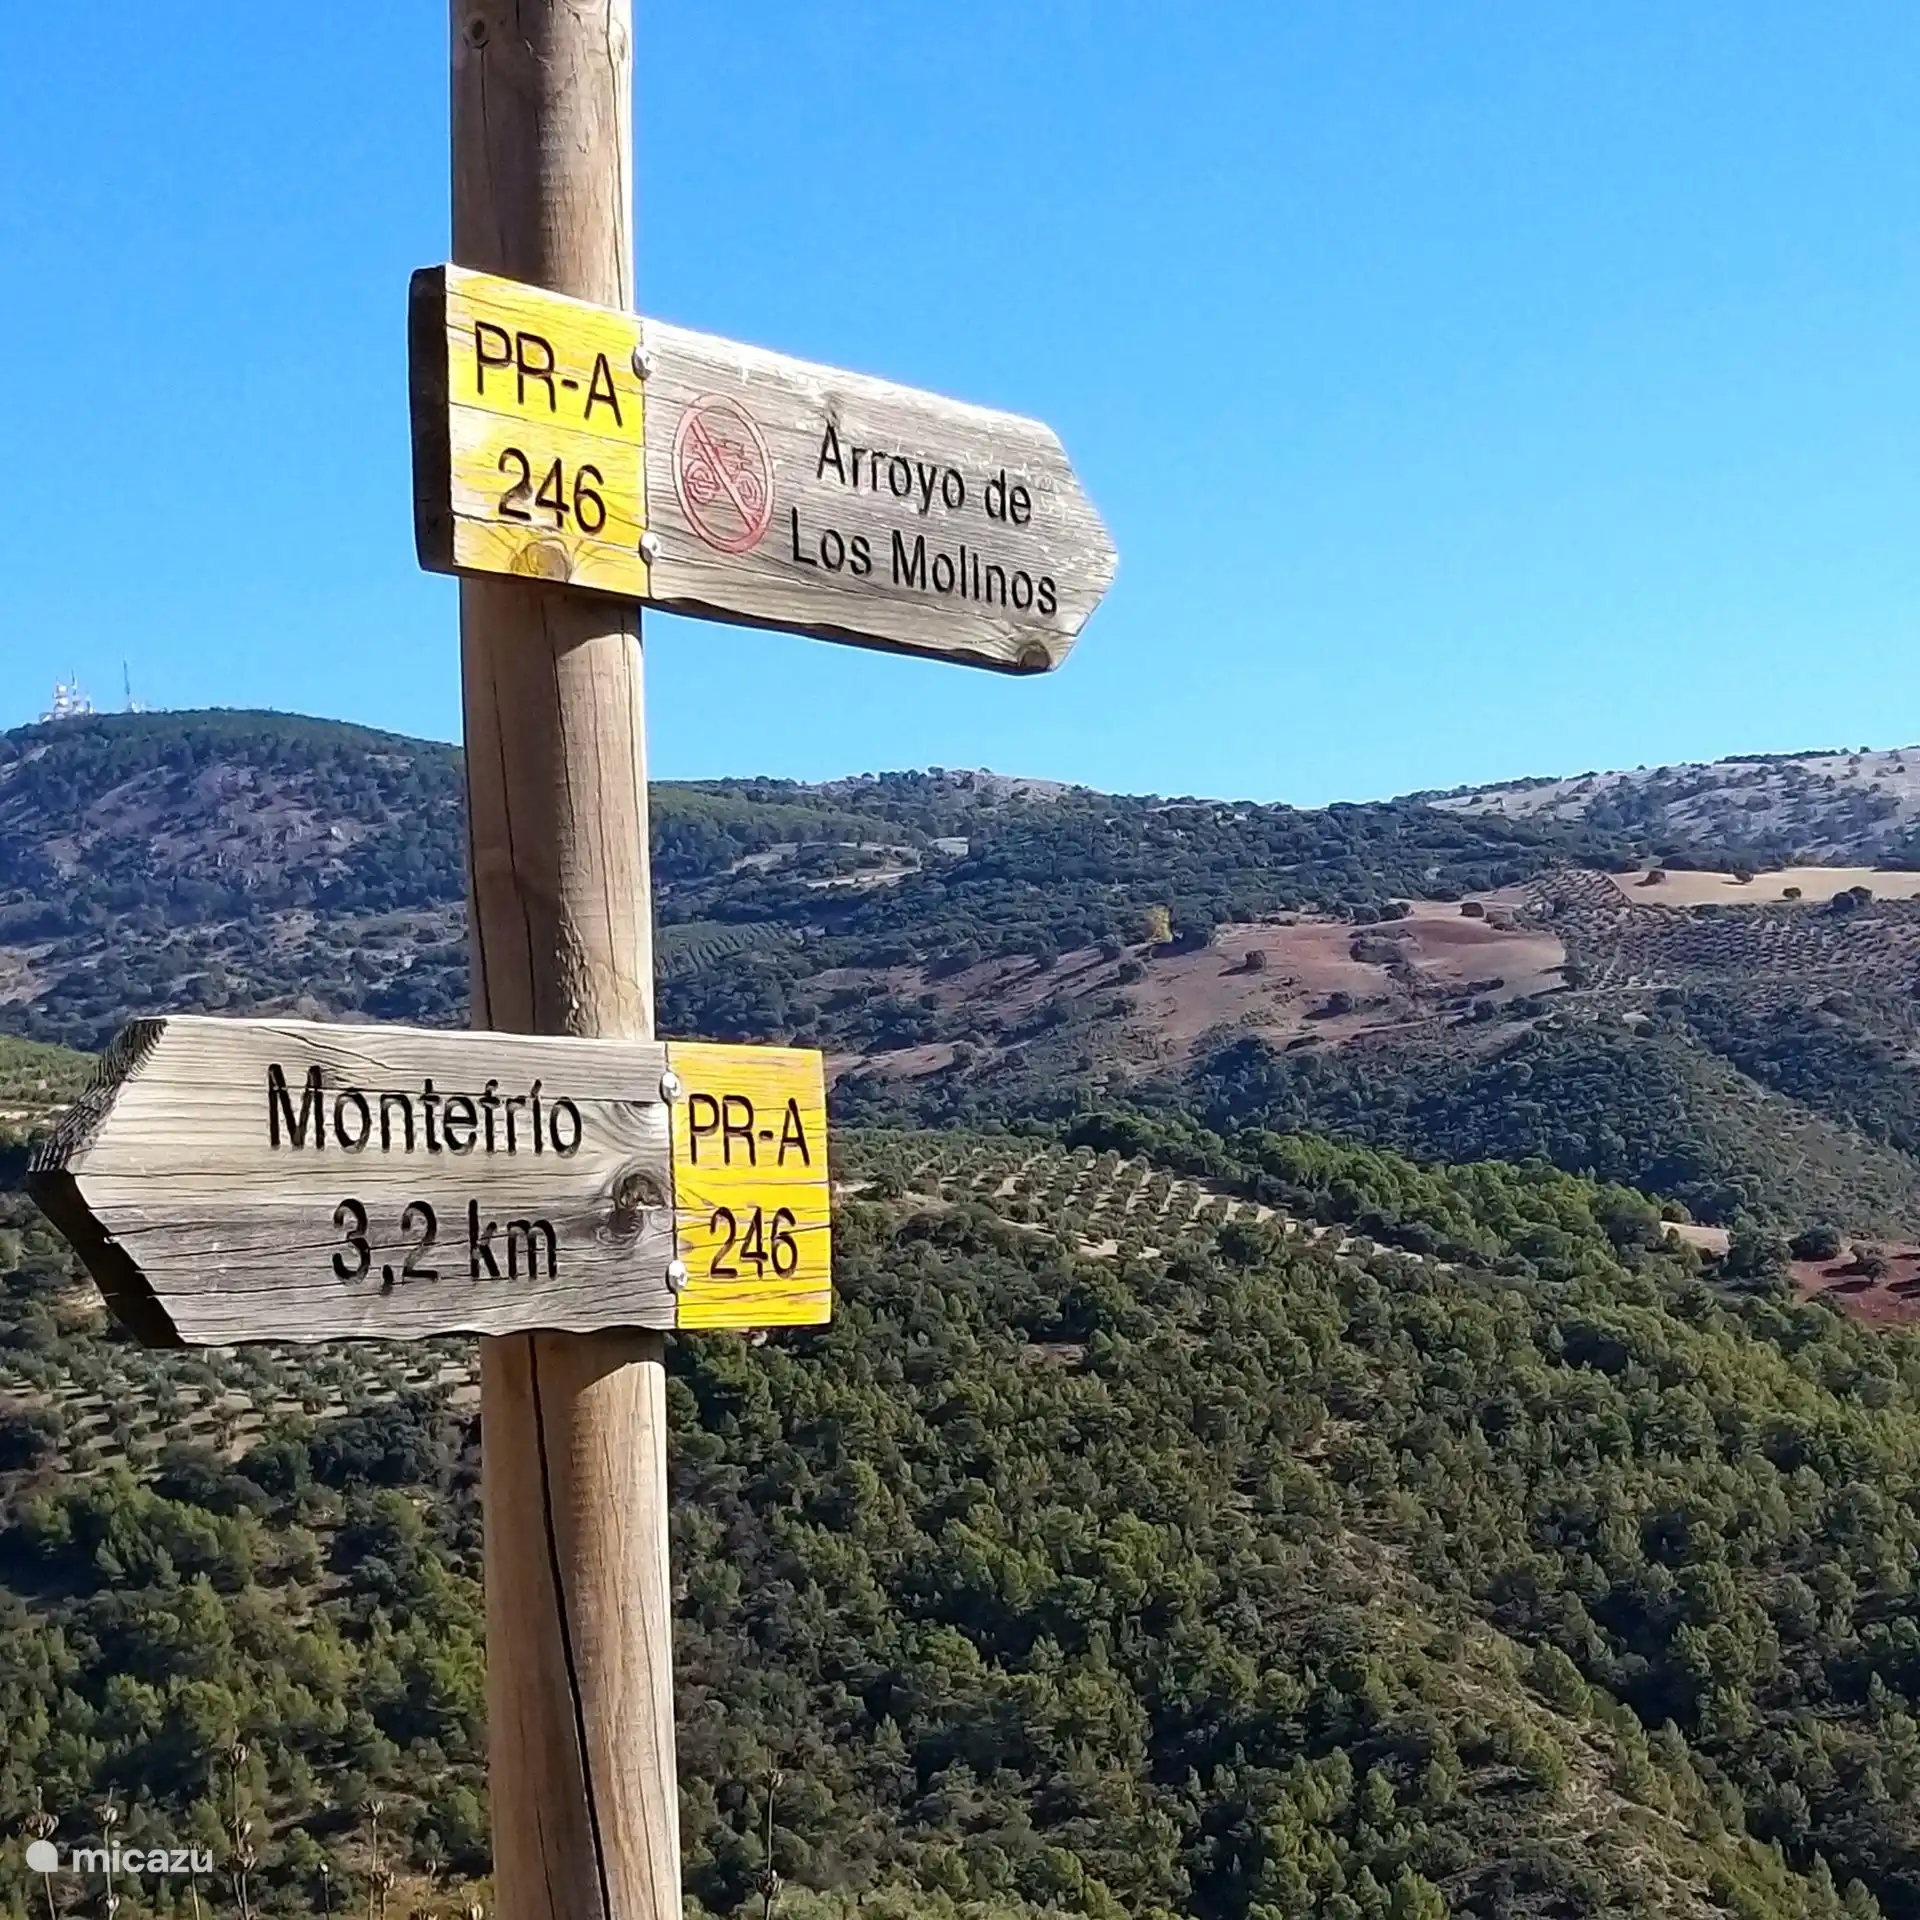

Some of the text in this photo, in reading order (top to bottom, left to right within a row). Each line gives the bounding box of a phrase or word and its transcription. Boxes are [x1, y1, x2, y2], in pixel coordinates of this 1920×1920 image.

[475, 321, 623, 428] PR-A
[498, 447, 606, 535] 246
[816, 425, 1032, 525] Arroyo de
[791, 507, 1058, 617] Los Molinos
[268, 1063, 583, 1158] Montefrío
[689, 1093, 811, 1167] PR-A
[332, 1198, 559, 1296] 3,2 km
[709, 1206, 798, 1280] 246
